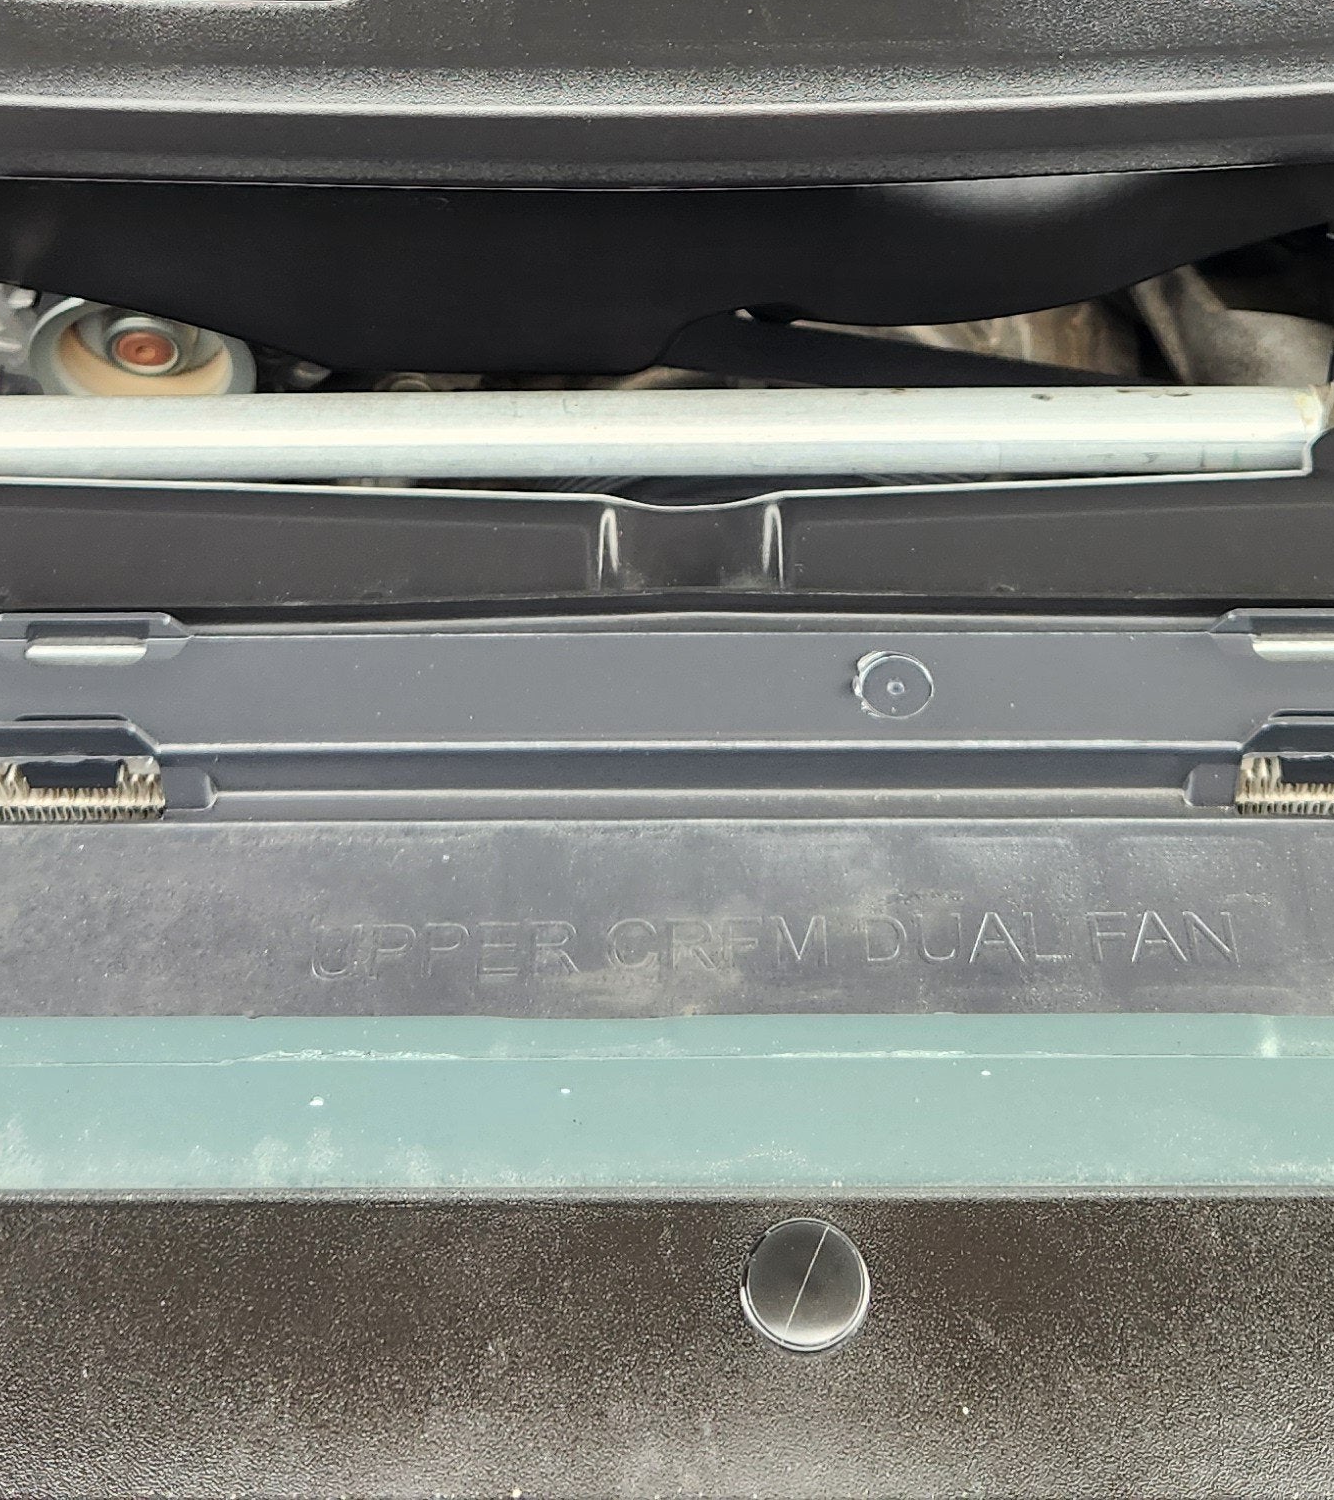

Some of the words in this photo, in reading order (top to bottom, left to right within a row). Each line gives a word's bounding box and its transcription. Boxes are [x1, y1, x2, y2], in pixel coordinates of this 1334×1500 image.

[310, 918, 581, 980] UPPER
[607, 915, 829, 972] CRFM
[861, 911, 1073, 966] DUAL
[1087, 908, 1240, 965] FAN
